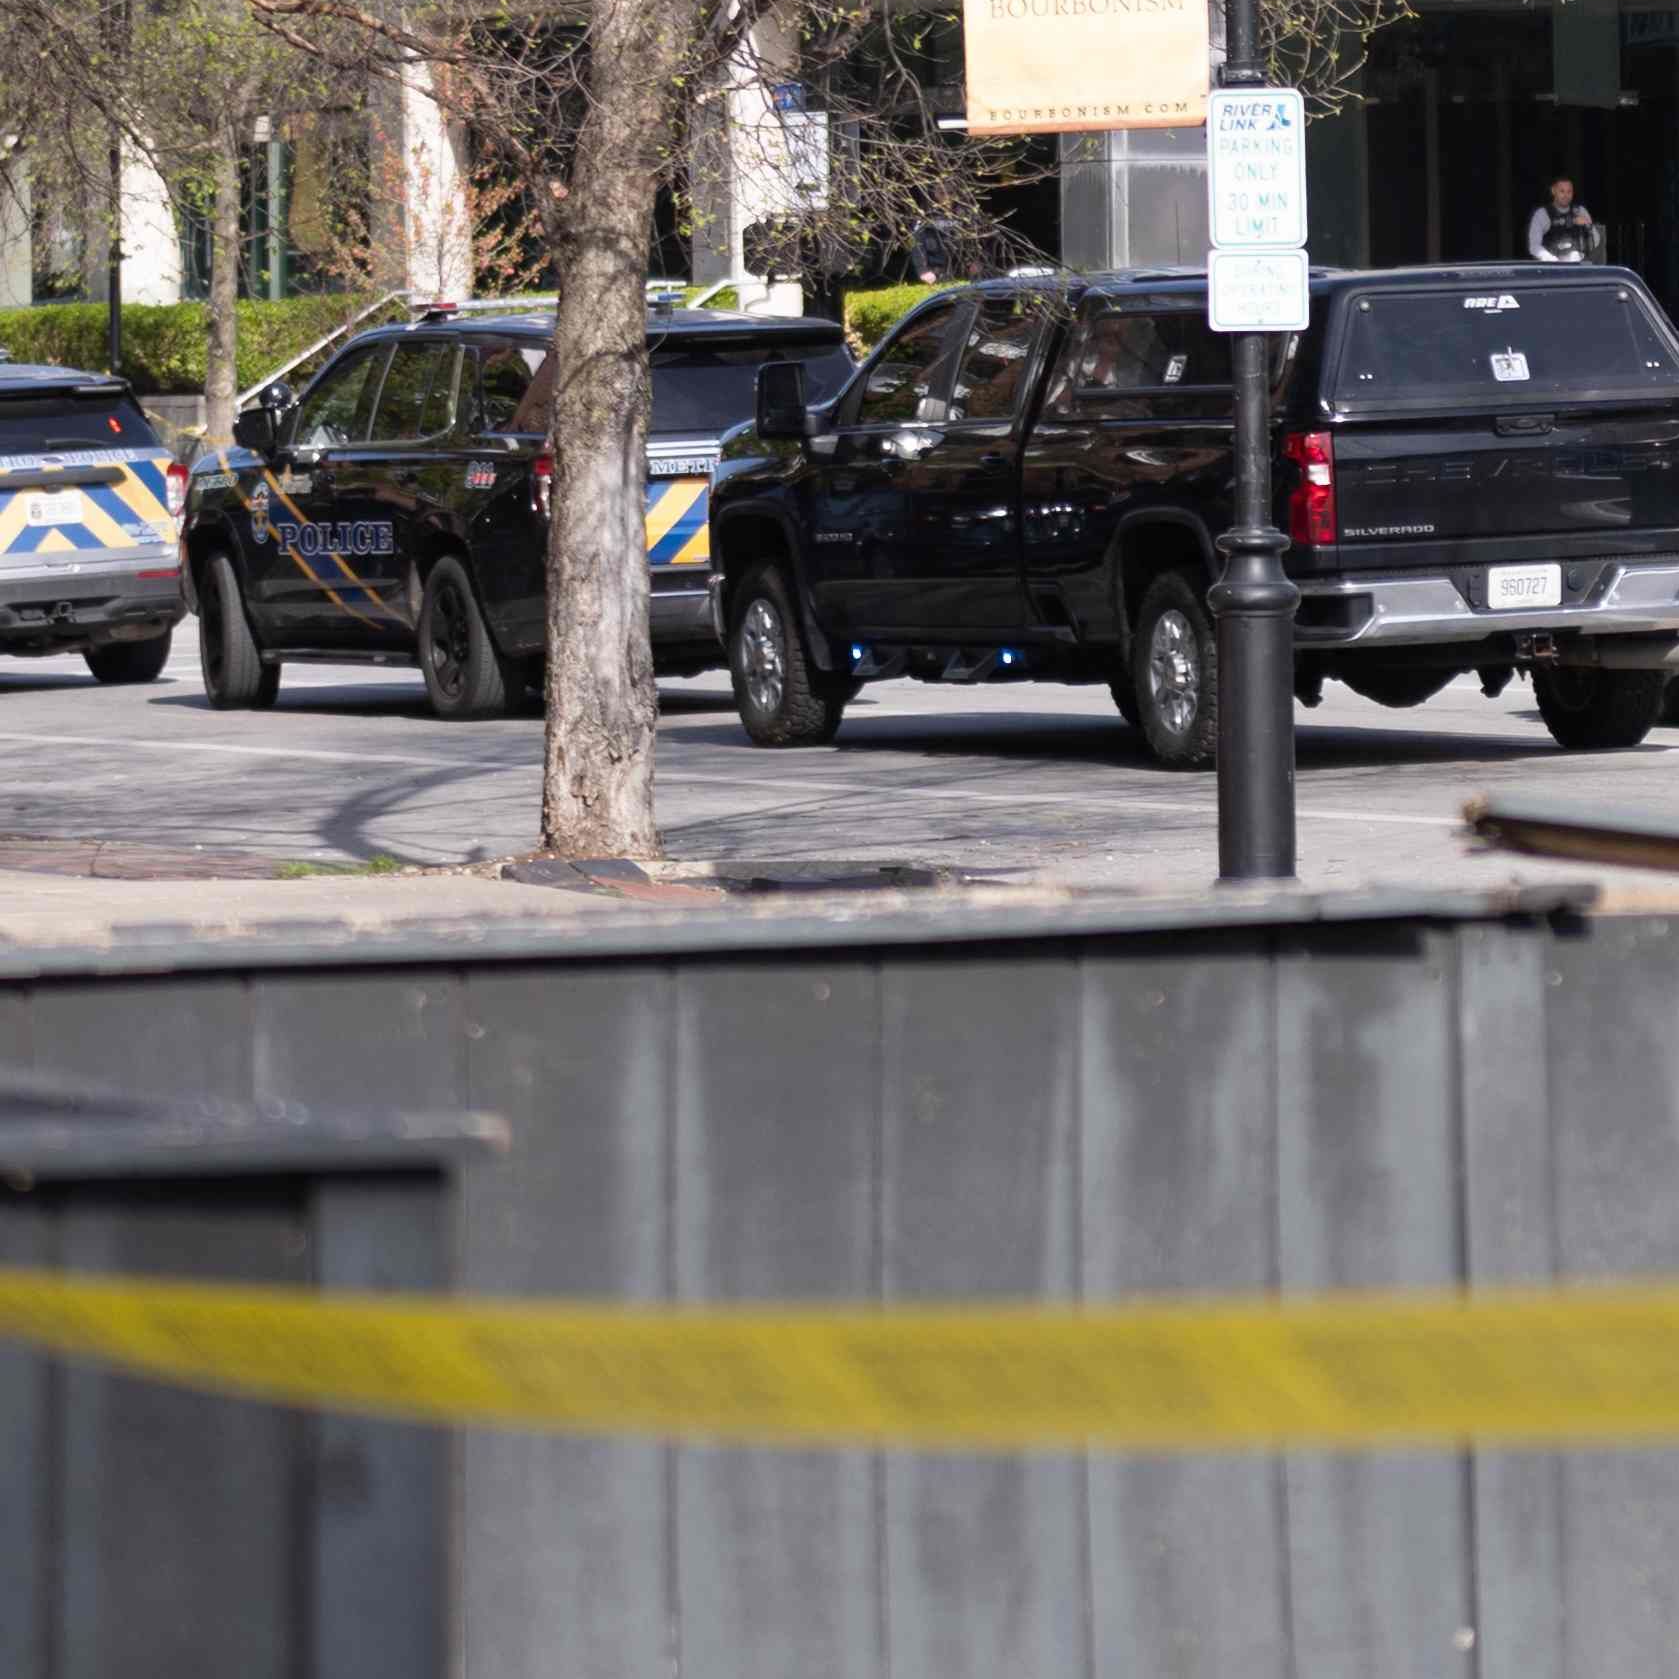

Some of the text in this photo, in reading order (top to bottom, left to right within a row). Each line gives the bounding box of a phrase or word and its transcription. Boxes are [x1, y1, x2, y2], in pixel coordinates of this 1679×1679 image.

[1222, 102, 1274, 118] RIVER
[1219, 119, 1259, 131] LINK
[1219, 137, 1294, 155] PARKING
[1233, 161, 1280, 182] ONLY
[1225, 192, 1289, 212] 30 MIN
[1234, 216, 1280, 236] LIMIT
[277, 519, 395, 558] POLICE
[1344, 524, 1435, 537] SILVERADO
